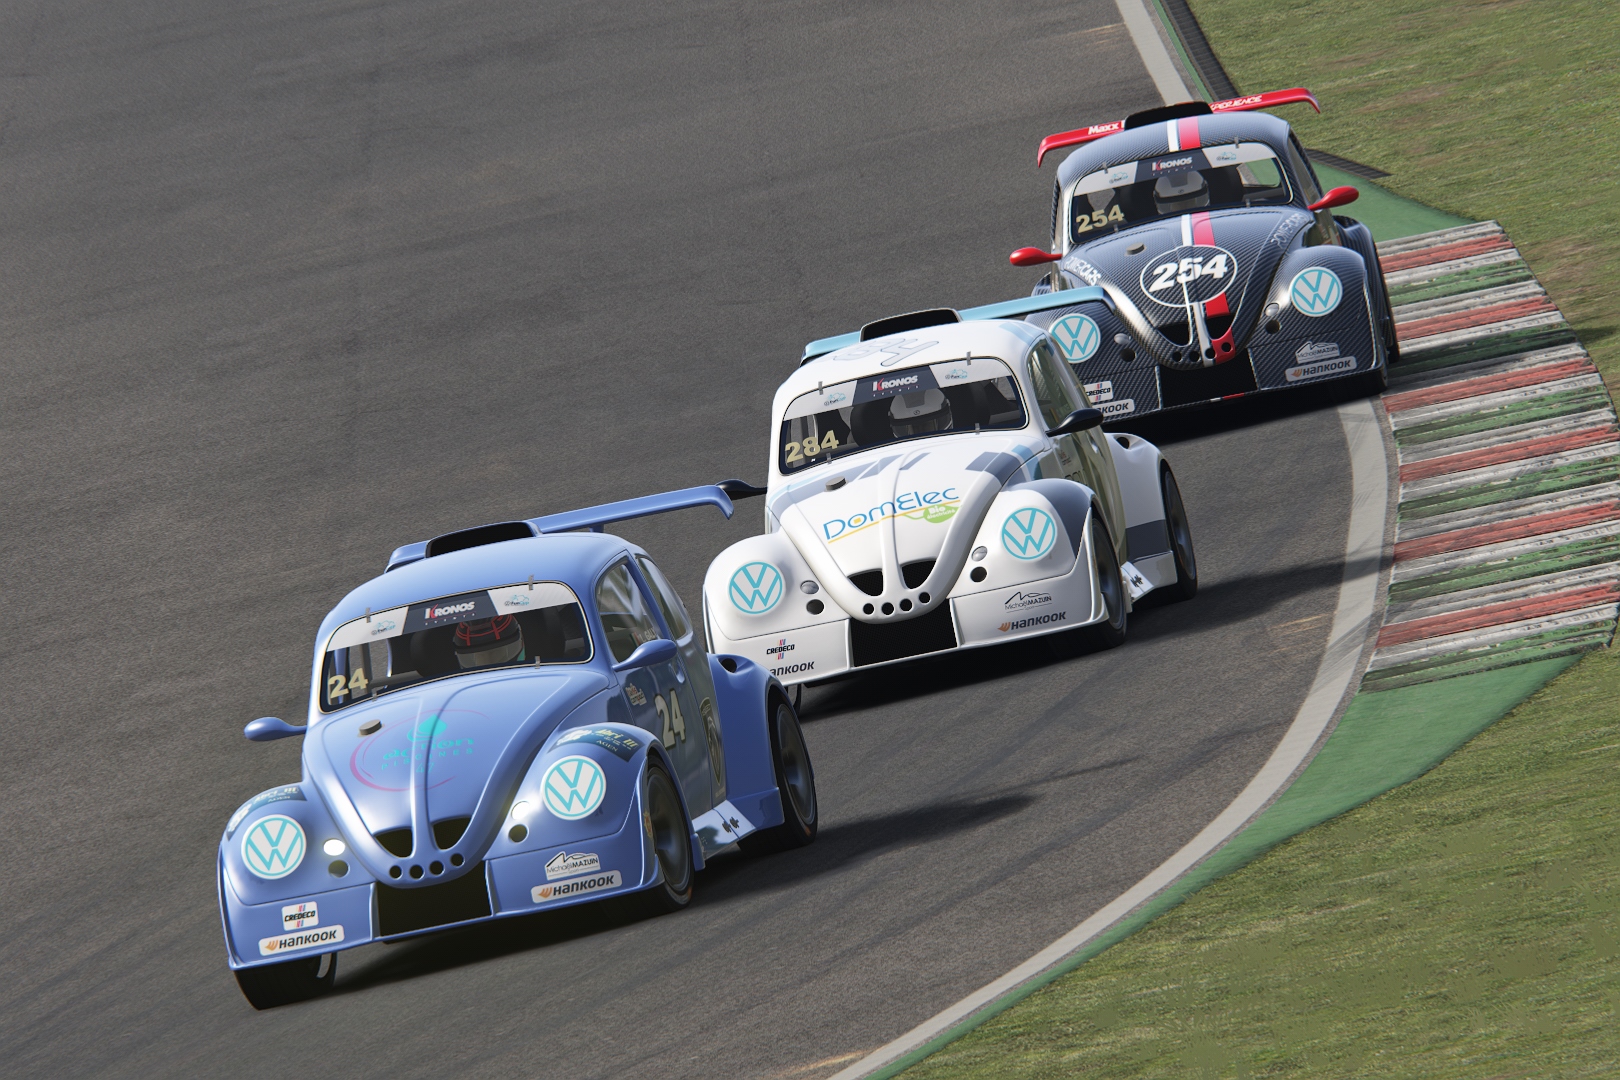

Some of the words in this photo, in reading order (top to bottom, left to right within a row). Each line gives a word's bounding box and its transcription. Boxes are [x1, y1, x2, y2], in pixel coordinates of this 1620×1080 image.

[1088, 122, 1119, 135] Maxx
[1151, 156, 1193, 171] KRONOS
[1075, 204, 1125, 233] 254
[1149, 254, 1228, 292] 254
[872, 375, 918, 391] KRONOS
[784, 429, 839, 463] 284
[823, 488, 960, 540] DomElec
[425, 601, 475, 619] KRONOS
[766, 644, 795, 655] CREDECO
[327, 667, 369, 699] 24
[654, 688, 686, 749] 24
[381, 747, 473, 770] PISCINES
[284, 910, 316, 922] CREDECO
